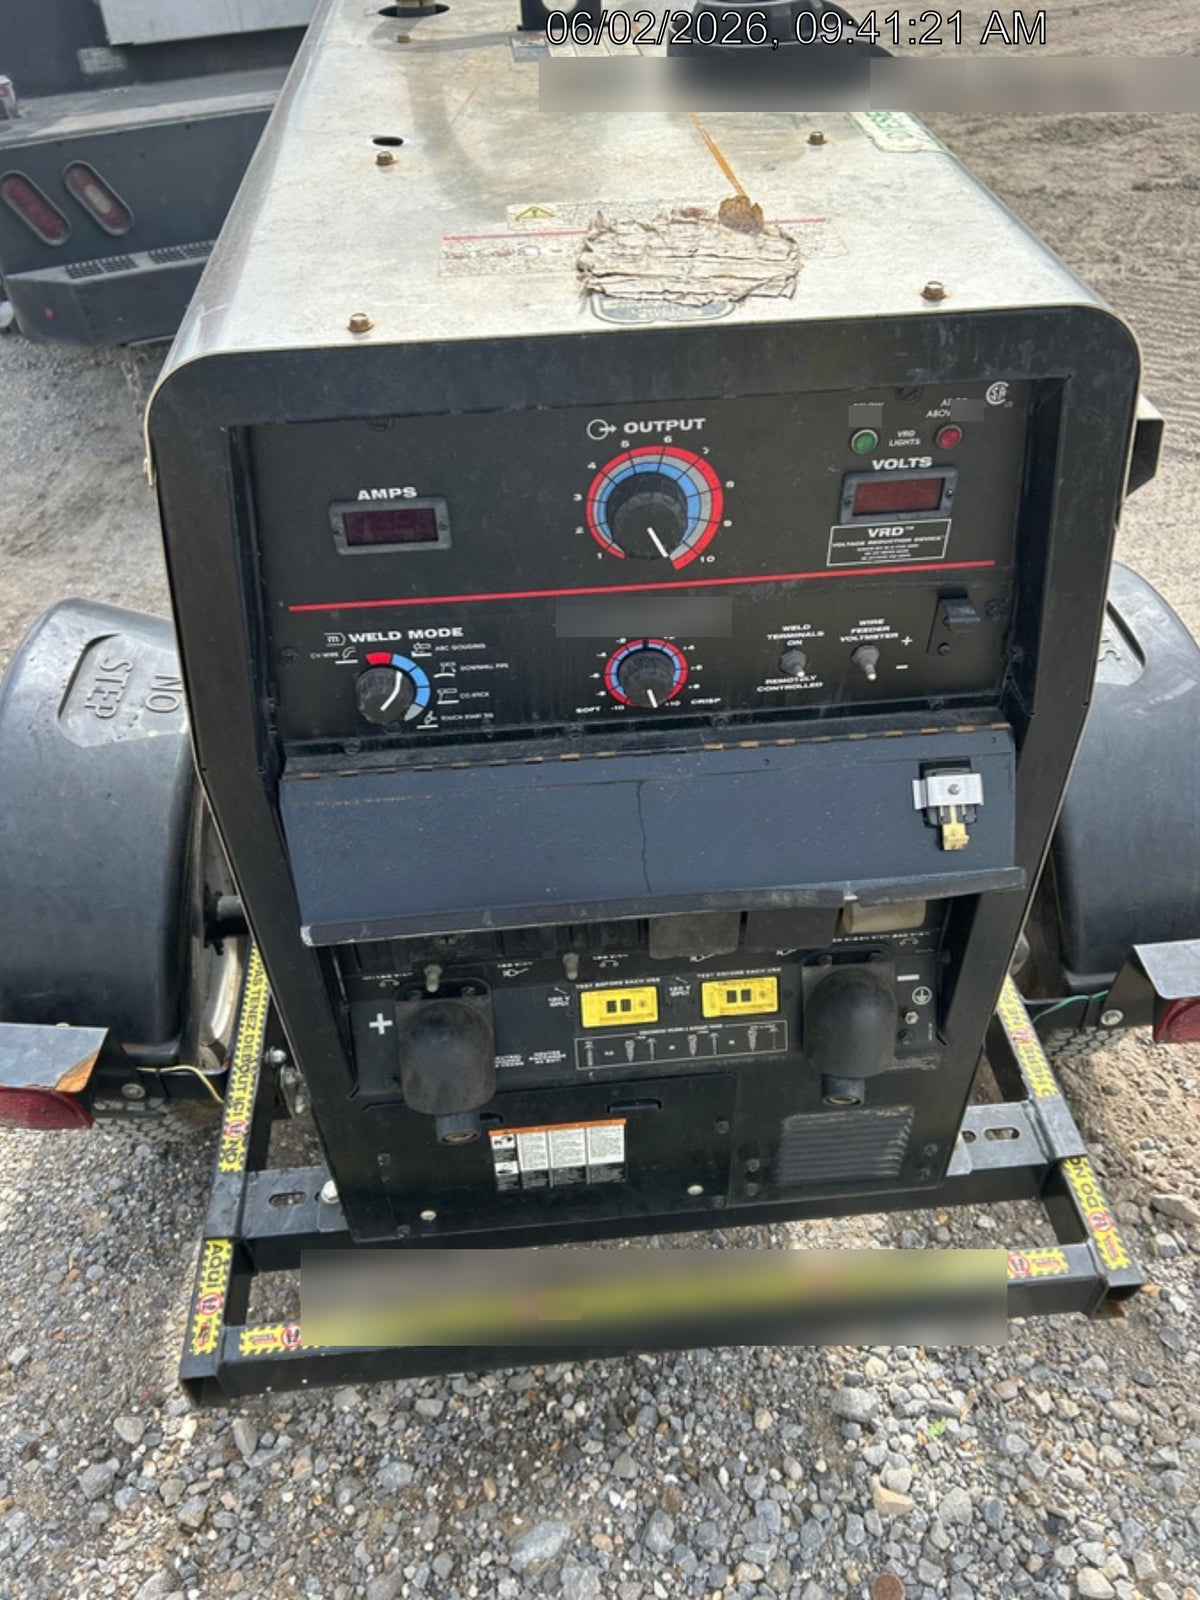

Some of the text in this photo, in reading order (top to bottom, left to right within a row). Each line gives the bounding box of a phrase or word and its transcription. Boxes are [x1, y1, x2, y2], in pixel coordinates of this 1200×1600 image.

[623, 417, 706, 434] OUTPUT
[896, 429, 916, 438] VRD
[663, 435, 673, 444] 6
[889, 438, 921, 447] LIGHTS
[587, 461, 597, 470] 4
[871, 456, 934, 470] VOLTS
[357, 486, 417, 501] AMPS
[573, 493, 583, 502] 3
[575, 526, 585, 535] 2
[700, 554, 716, 564] 10
[858, 618, 886, 626] WIRE
[781, 624, 811, 632] WELD
[850, 625, 891, 634] FEEDER
[348, 630, 402, 643] WELD
[408, 627, 464, 640] MODE
[766, 631, 824, 640] TERMINALS
[839, 632, 899, 643] VOLTMETER
[84, 656, 133, 720] STEP
[756, 681, 824, 693] CONTROLLED
[145, 674, 183, 714] NO
[690, 697, 723, 706] CRISP
[575, 705, 602, 715] SOFT
[245, 988, 262, 1032] TENEZ
[1081, 1183, 1099, 1208] DO
